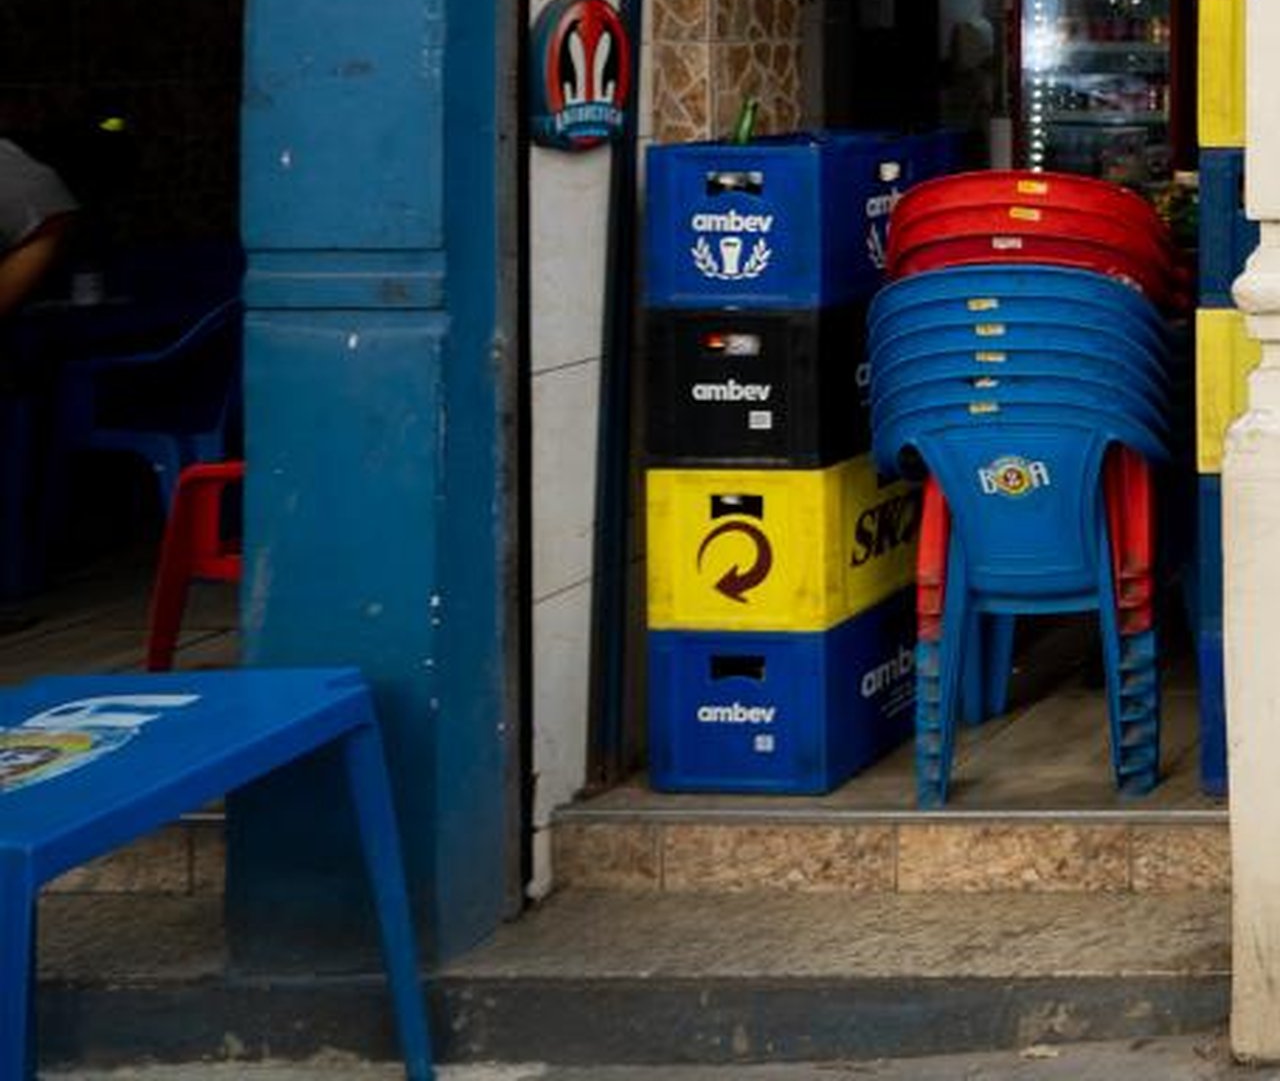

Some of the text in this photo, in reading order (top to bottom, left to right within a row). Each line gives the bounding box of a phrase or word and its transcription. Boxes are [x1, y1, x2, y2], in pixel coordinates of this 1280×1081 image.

[692, 210, 774, 232] ambev
[692, 379, 772, 401] ambev
[697, 703, 776, 723] ambev
